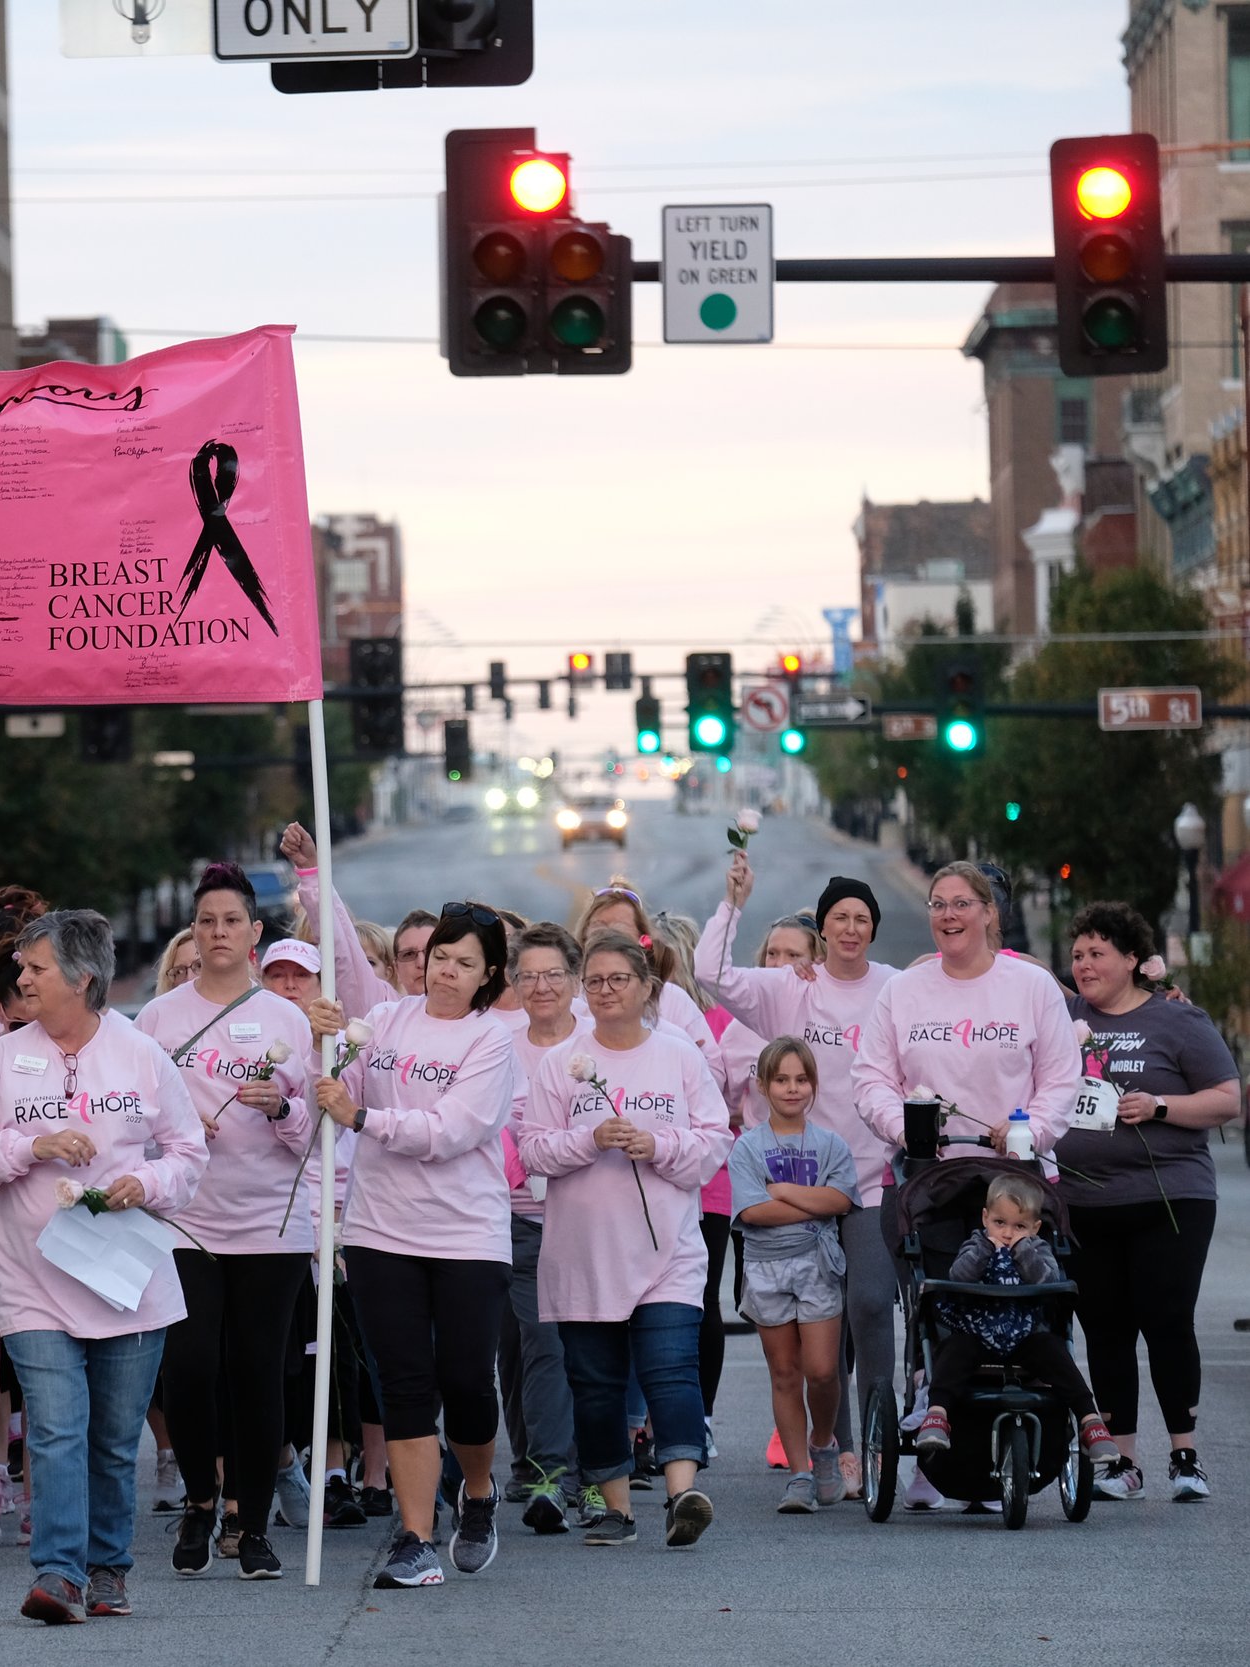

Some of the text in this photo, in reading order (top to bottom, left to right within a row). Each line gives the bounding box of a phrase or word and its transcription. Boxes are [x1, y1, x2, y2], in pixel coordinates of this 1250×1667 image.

[244, 0, 381, 37] ONLY
[676, 216, 759, 232] LEFT TURN
[689, 240, 748, 260] YIELD
[679, 268, 758, 285] ON GREEN
[48, 558, 168, 588] BREAST
[48, 590, 177, 620] CANCER
[47, 617, 250, 651] FOUNDATION
[1111, 694, 1191, 724] 5th St
[972, 1026, 1019, 1042] HOPE
[999, 1042, 1018, 1050] 2022
[216, 1059, 260, 1081] HOP
[1110, 1060, 1145, 1073] MOBLEY
[14, 1096, 32, 1106] 13TH
[14, 1101, 68, 1125] RACE
[91, 1096, 143, 1114] HOPE
[625, 1096, 675, 1115] HOPE
[1075, 1095, 1099, 1116] 55
[125, 1114, 143, 1124] 2022
[655, 1113, 674, 1123] 2022
